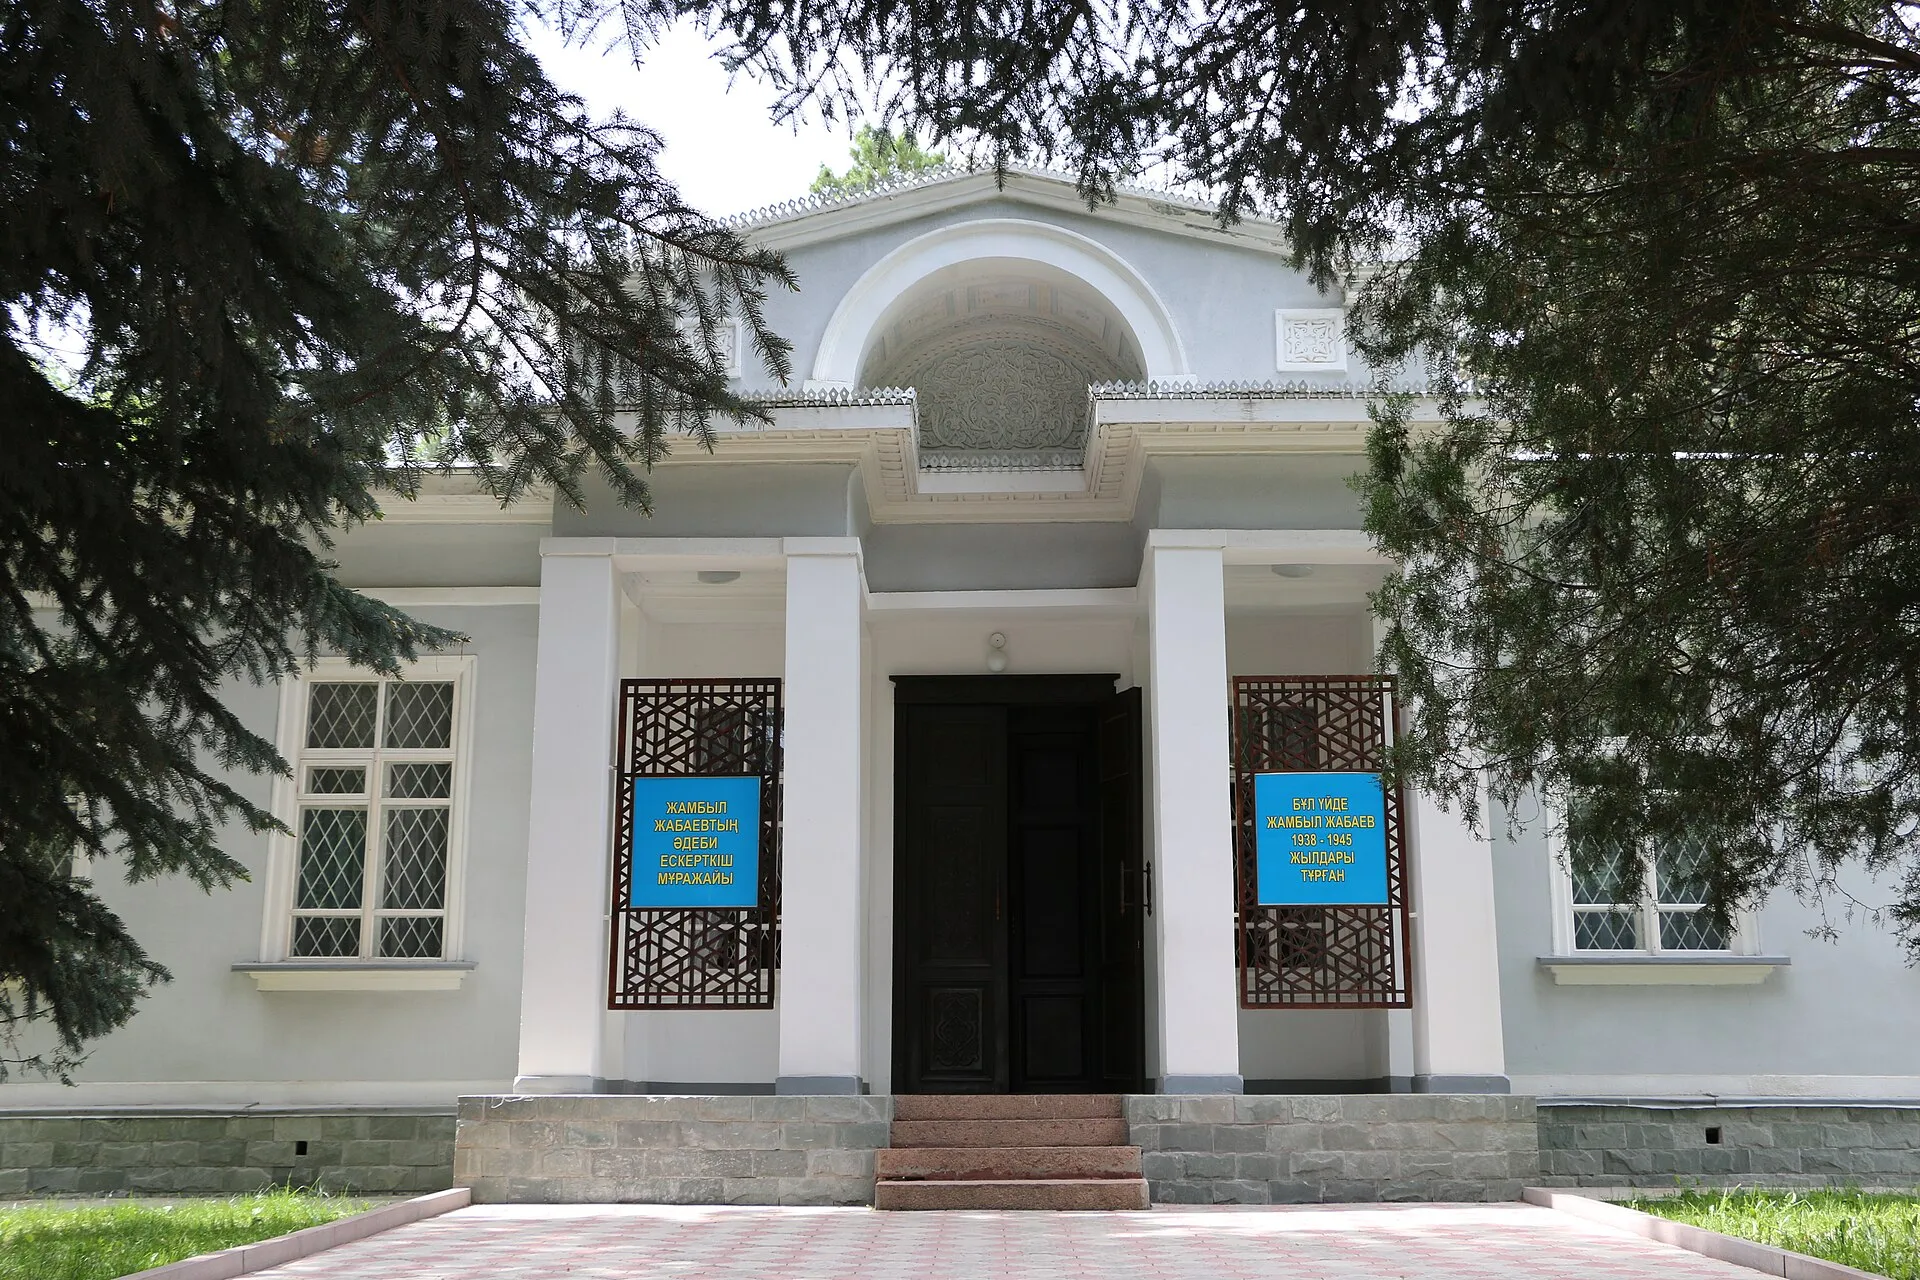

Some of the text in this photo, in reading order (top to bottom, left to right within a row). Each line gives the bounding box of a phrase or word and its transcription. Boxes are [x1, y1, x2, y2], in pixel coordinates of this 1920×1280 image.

[666, 801, 727, 815] ЖАМБЫЛ
[1292, 795, 1349, 813] БҰЛ ҮЙДЕ
[654, 818, 739, 834] ЖАБАЕВТЫҢ
[1266, 815, 1375, 829] ЖАМБЫЛ ЖАБАЕВ
[673, 836, 718, 851] ӘДЕБИ
[1291, 833, 1317, 847] 1938
[1327, 833, 1352, 847] 1945
[660, 854, 733, 868] ЕСКЕРТКІШ
[1289, 851, 1355, 866] ЖЫЛДАРЫ
[657, 869, 733, 885] МҰРАЖАЙЫ
[1300, 868, 1345, 883] ТҰРҒАН
